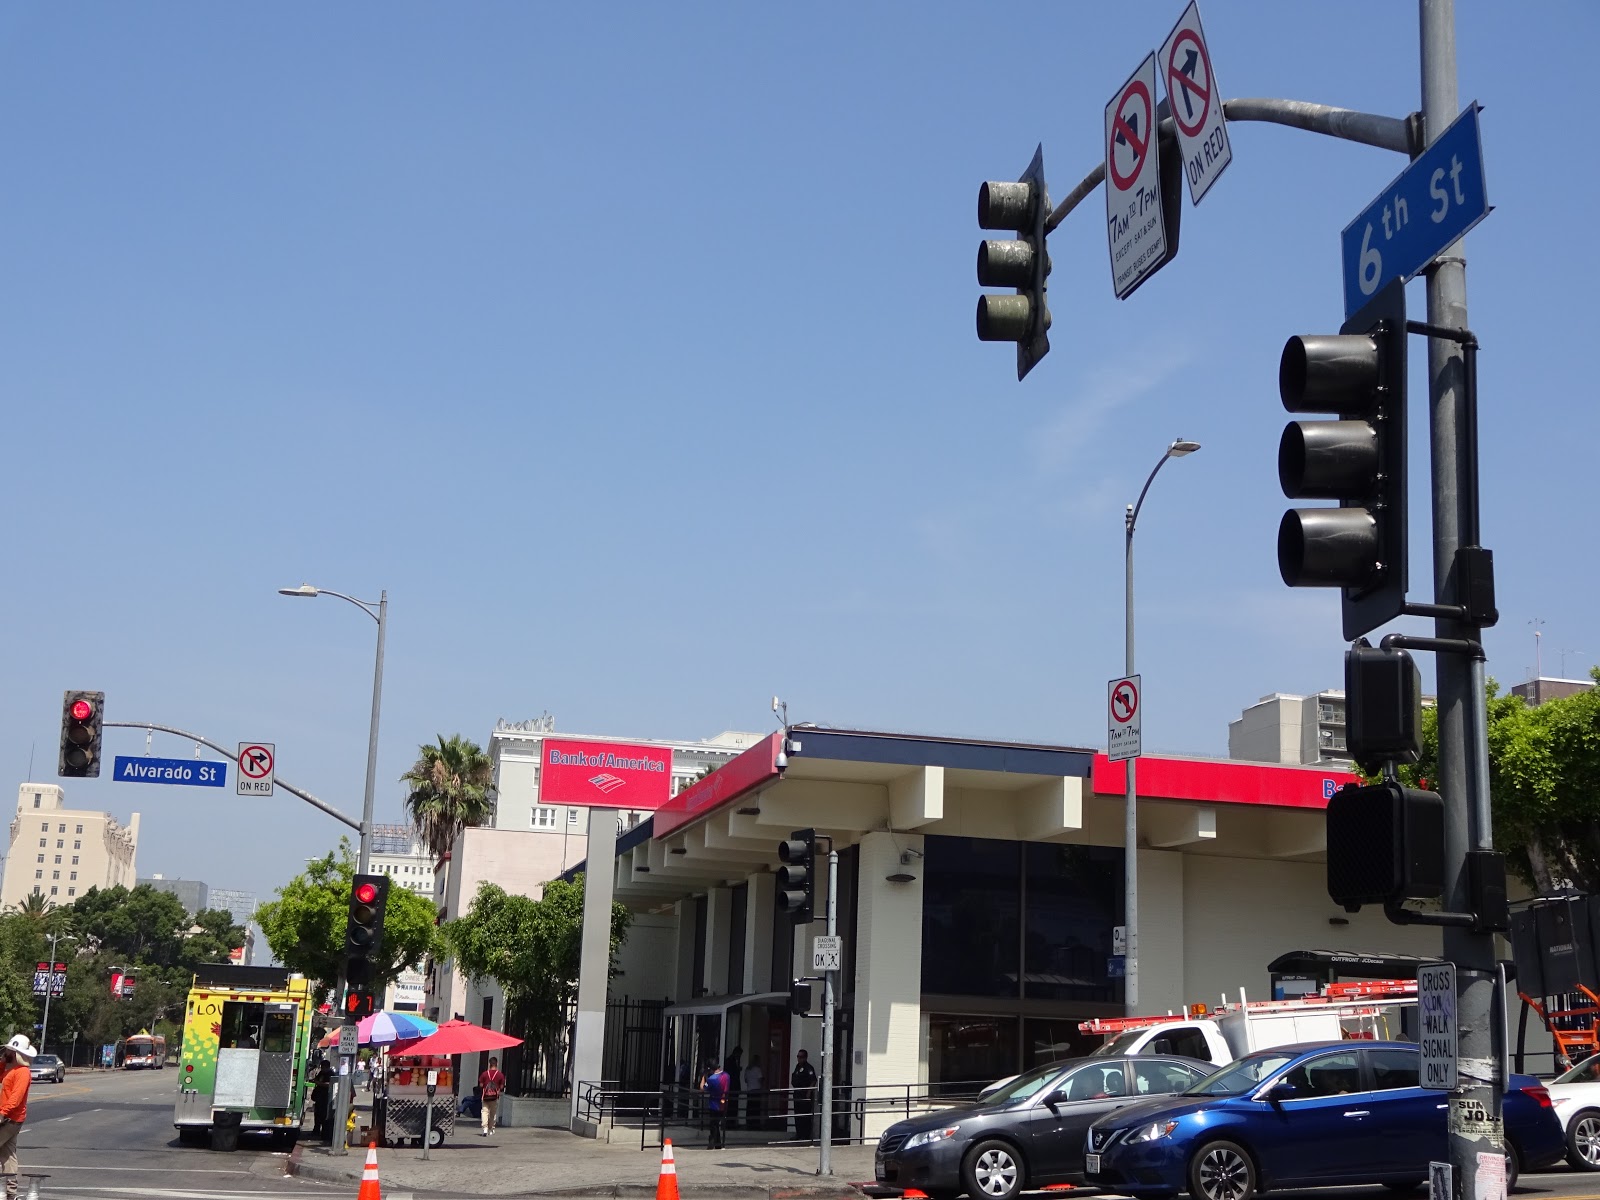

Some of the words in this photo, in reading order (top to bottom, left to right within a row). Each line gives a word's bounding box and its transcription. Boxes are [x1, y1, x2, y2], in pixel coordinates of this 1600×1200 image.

[1189, 151, 1204, 186] ON
[1203, 125, 1224, 168] RED
[1110, 214, 1130, 243] 7AM
[1128, 202, 1136, 217] TO
[1136, 185, 1158, 216] 7PM
[1358, 193, 1409, 296] 6th
[1430, 152, 1465, 224] St
[1115, 239, 1133, 262] EXCEPT
[1134, 229, 1143, 244] SAT
[1147, 216, 1157, 231] SUN
[1117, 265, 1133, 285] TRANSIT
[1133, 253, 1146, 270] BUSES
[1146, 237, 1162, 258] EXEMPT
[1109, 729, 1122, 740] 7AM
[1127, 725, 1140, 737] 7PM
[123, 762, 192, 780] Alvarado
[199, 766, 217, 781] St
[240, 781, 251, 791] ON
[254, 782, 270, 792] RED
[815, 953, 825, 967] OK
[1422, 971, 1450, 992] CROSS
[1432, 995, 1442, 1011] ON
[1426, 1014, 1449, 1034] WALK
[1423, 1039, 1453, 1058] SIGNAL
[1427, 1063, 1449, 1083] ONLY
